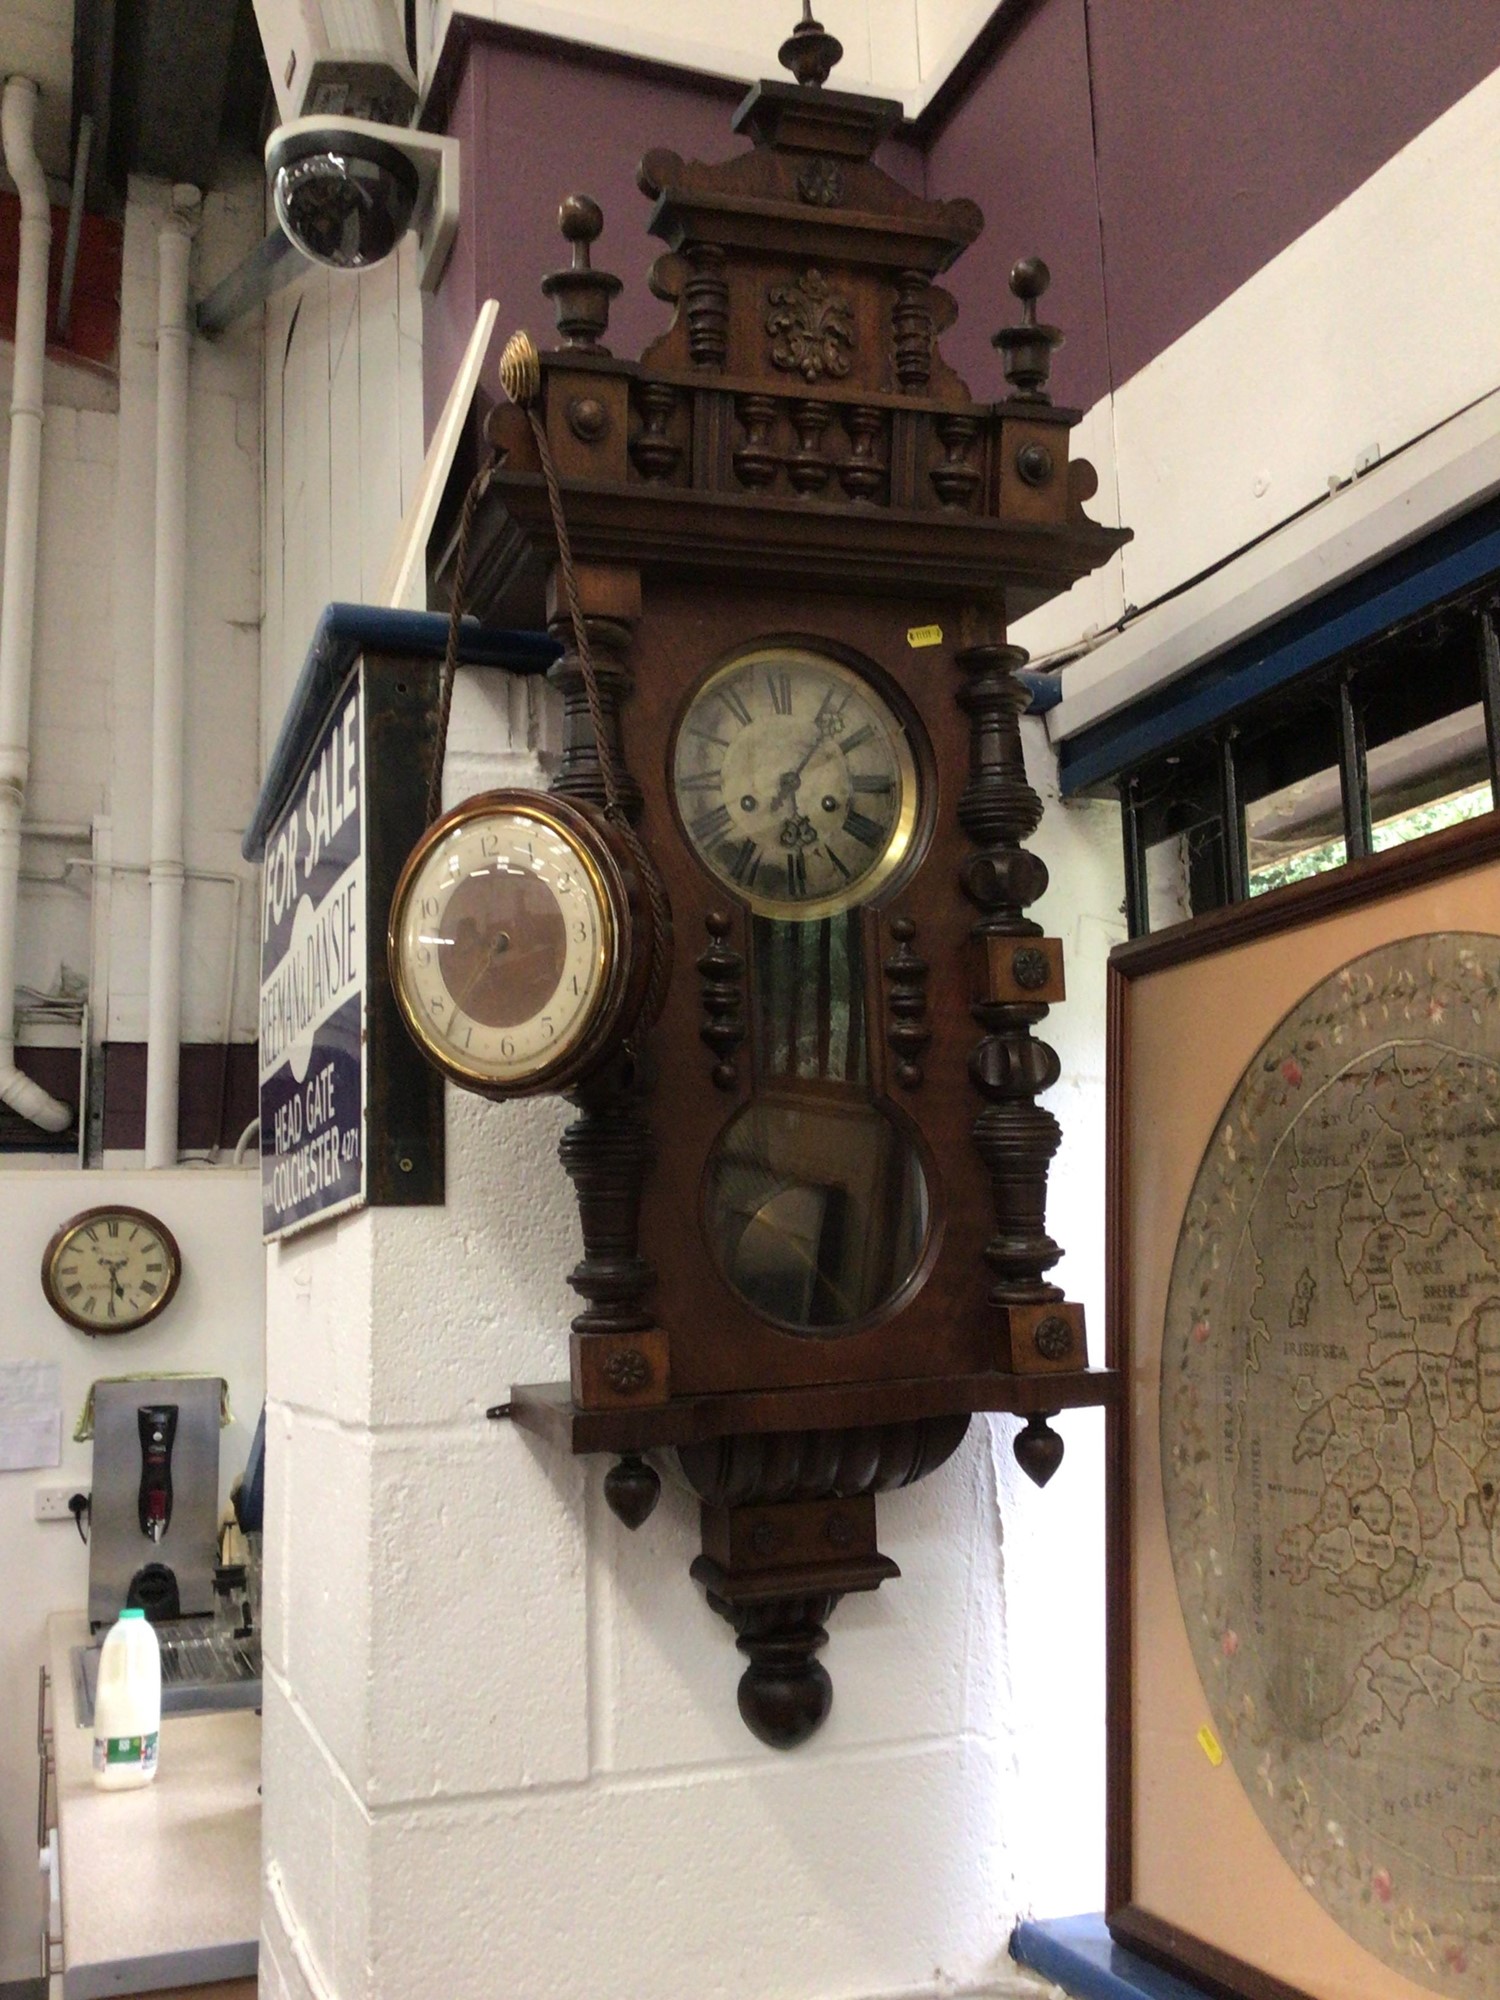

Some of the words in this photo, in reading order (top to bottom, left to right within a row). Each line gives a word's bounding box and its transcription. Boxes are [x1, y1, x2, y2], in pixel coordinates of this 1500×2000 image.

[264, 810, 299, 945] FOR
[305, 696, 357, 878] SALE
[480, 835, 500, 858] 12
[419, 897, 440, 919] 10
[572, 921, 587, 944] 3
[417, 950, 431, 968] 9
[566, 974, 582, 997] 4
[430, 997, 444, 1015] 8
[541, 1017, 554, 1039] 5
[501, 1036, 515, 1058] 6
[274, 1093, 303, 1157] HEAD
[305, 1062, 336, 1134] GATE
[273, 1125, 341, 1215] COLCHESTER
[341, 1128, 359, 1163] 4271
